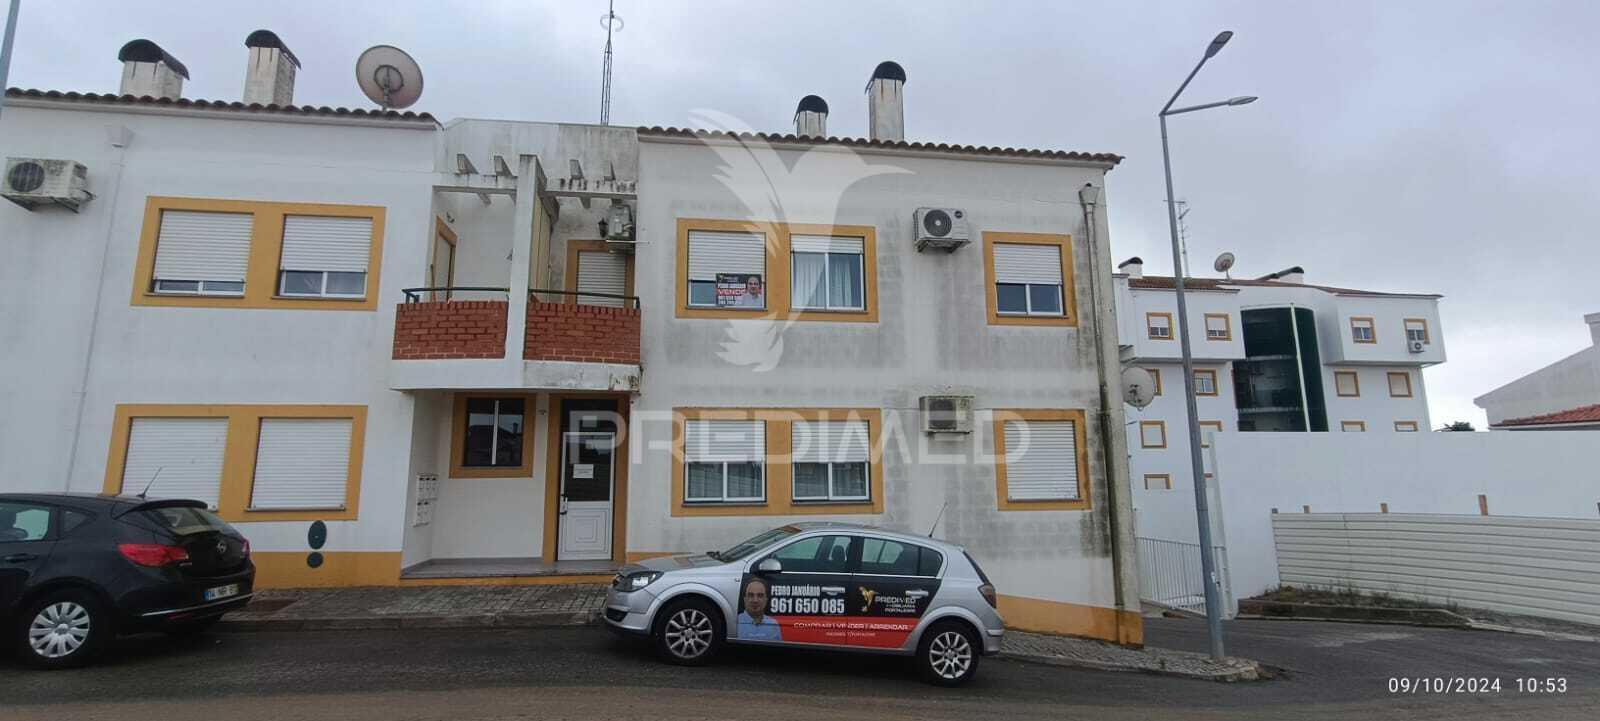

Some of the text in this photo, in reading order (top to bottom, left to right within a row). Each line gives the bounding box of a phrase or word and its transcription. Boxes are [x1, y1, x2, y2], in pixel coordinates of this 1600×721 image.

[771, 585, 790, 596] PEDRO
[770, 598, 845, 615] 961 650 085
[869, 623, 909, 631] ARRENDAR
